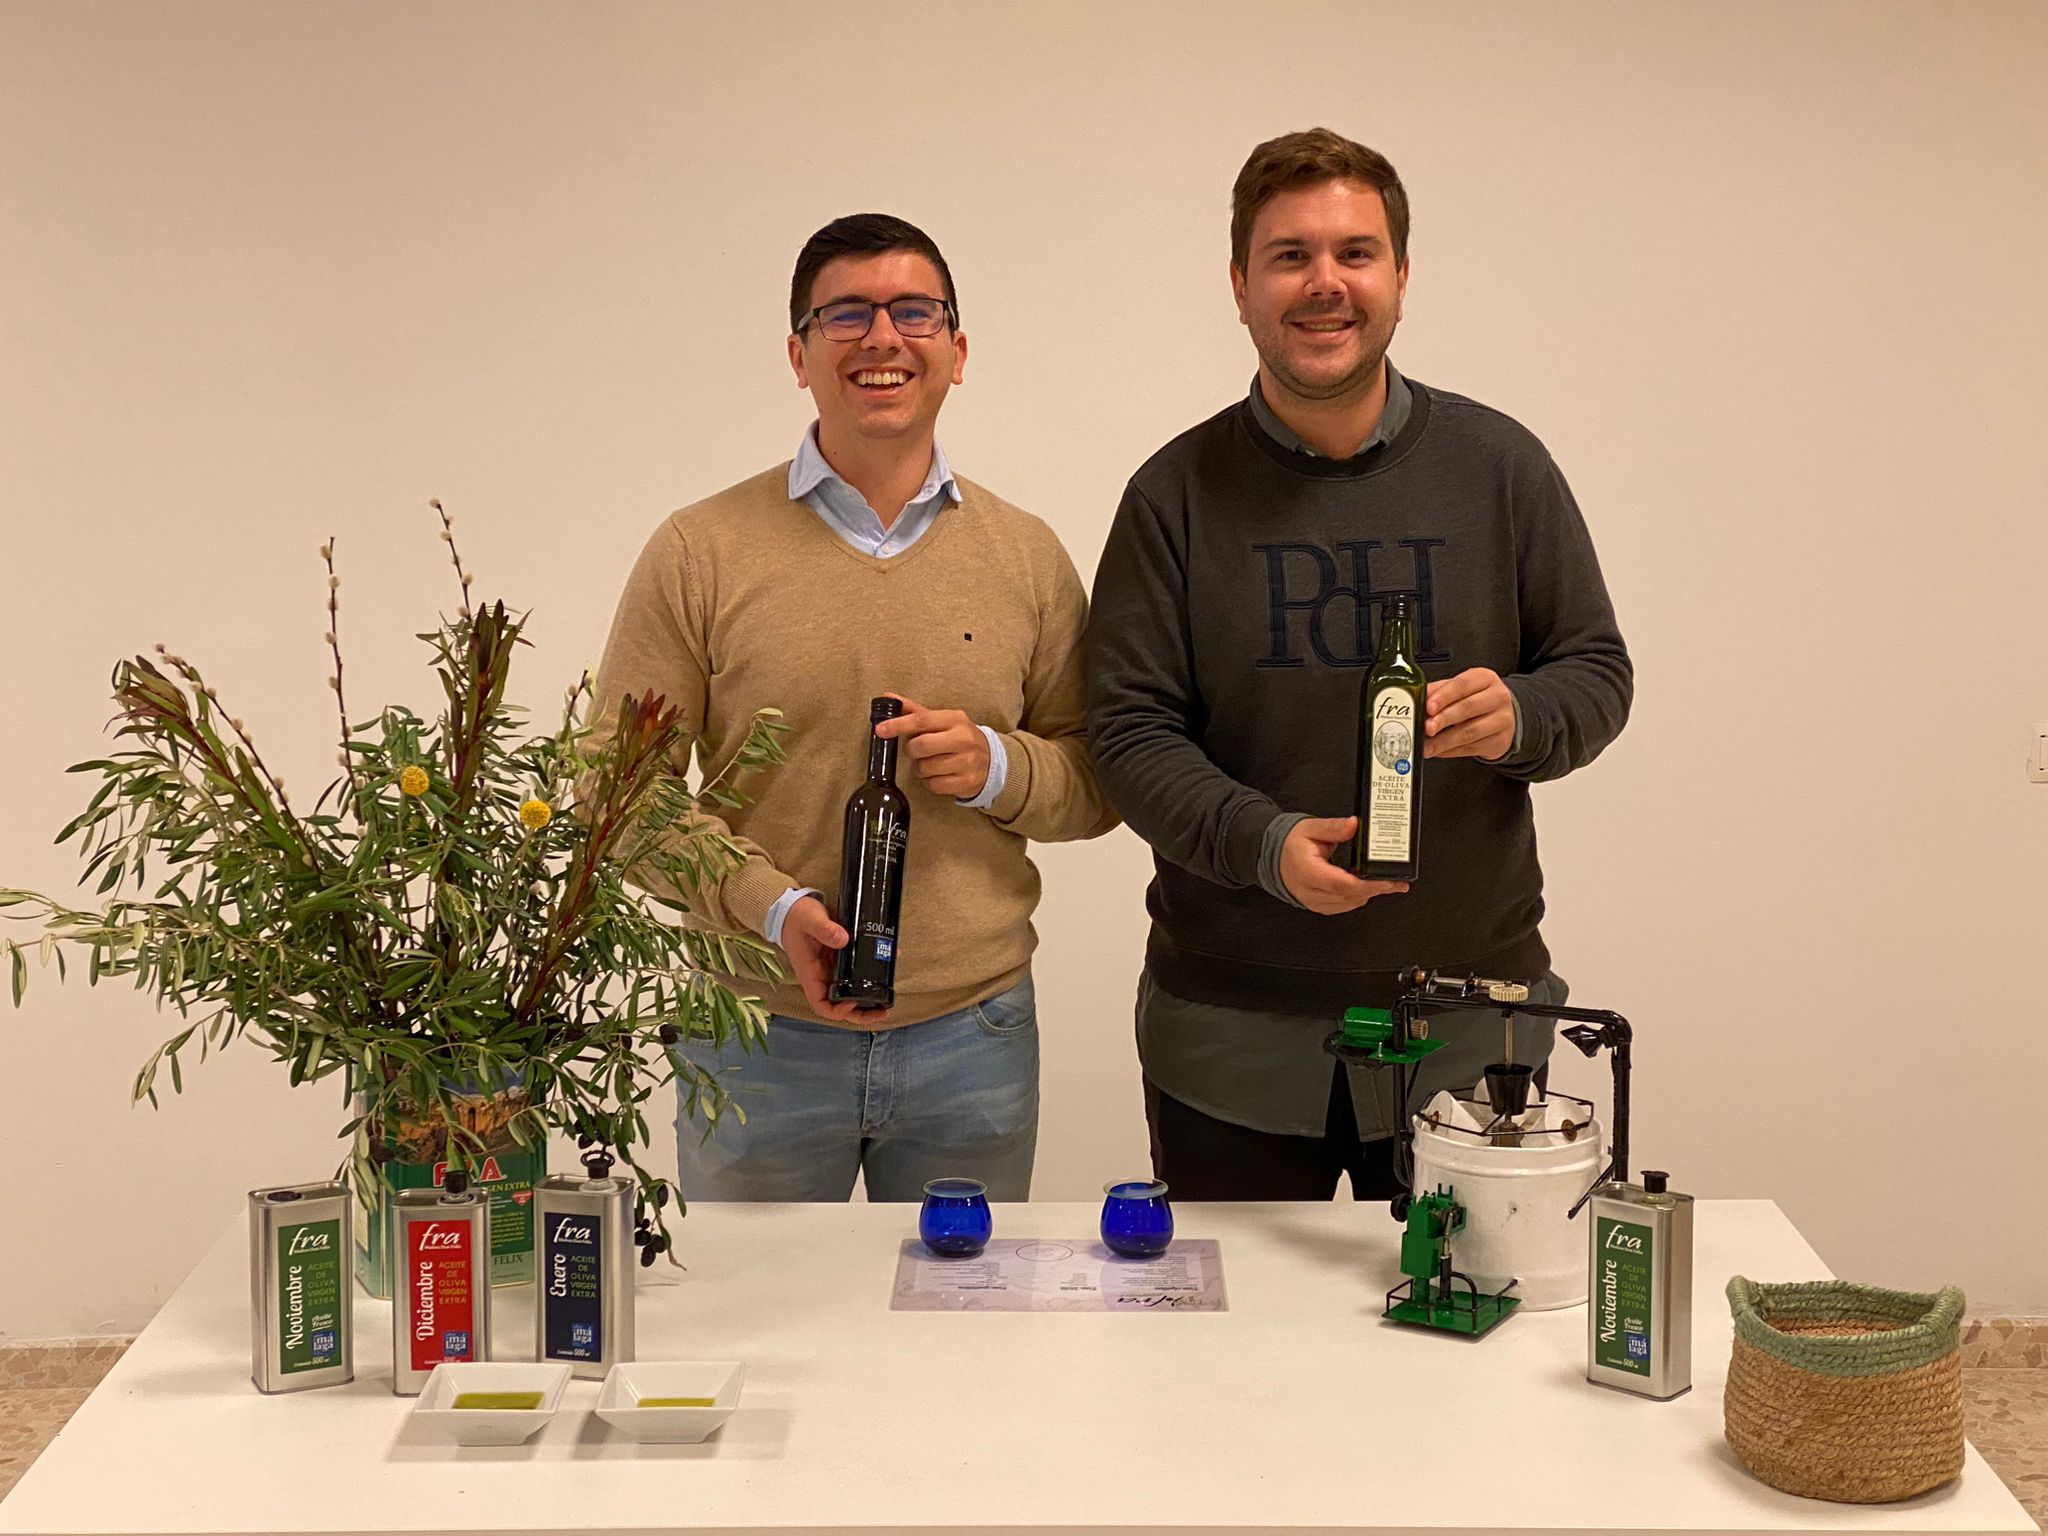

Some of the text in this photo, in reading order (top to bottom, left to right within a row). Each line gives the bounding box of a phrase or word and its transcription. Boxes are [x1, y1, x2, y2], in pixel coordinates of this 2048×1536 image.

[1376, 697, 1410, 719] fra
[866, 921, 895, 936] 500 ml
[433, 1156, 502, 1188] FA
[505, 1181, 530, 1190] EXTRA
[553, 1217, 591, 1243] fra
[289, 1227, 328, 1255] fra
[419, 1223, 460, 1251] fra
[1605, 1224, 1642, 1249] fra
[439, 1261, 466, 1269] ACEITE
[494, 1255, 523, 1266] FELIX
[571, 1255, 596, 1264] ACEITE
[578, 1264, 588, 1272] DE
[315, 1271, 326, 1279] DE
[446, 1270, 458, 1278] DE
[549, 1253, 567, 1298] Enero
[571, 1272, 596, 1281] OLIVA
[1629, 1274, 1640, 1282] DE
[307, 1279, 335, 1289] OLIVA
[571, 1281, 597, 1290] VIRGEN
[1621, 1281, 1647, 1293] OLIVA
[439, 1296, 467, 1304] EXTRA
[571, 1290, 596, 1299] EXTRA
[307, 1297, 335, 1306] EXTRA
[416, 1261, 435, 1341] Diciembre
[1600, 1259, 1617, 1343] Noviembre
[1621, 1298, 1646, 1310] EXTRA
[285, 1265, 304, 1350] Noviembre
